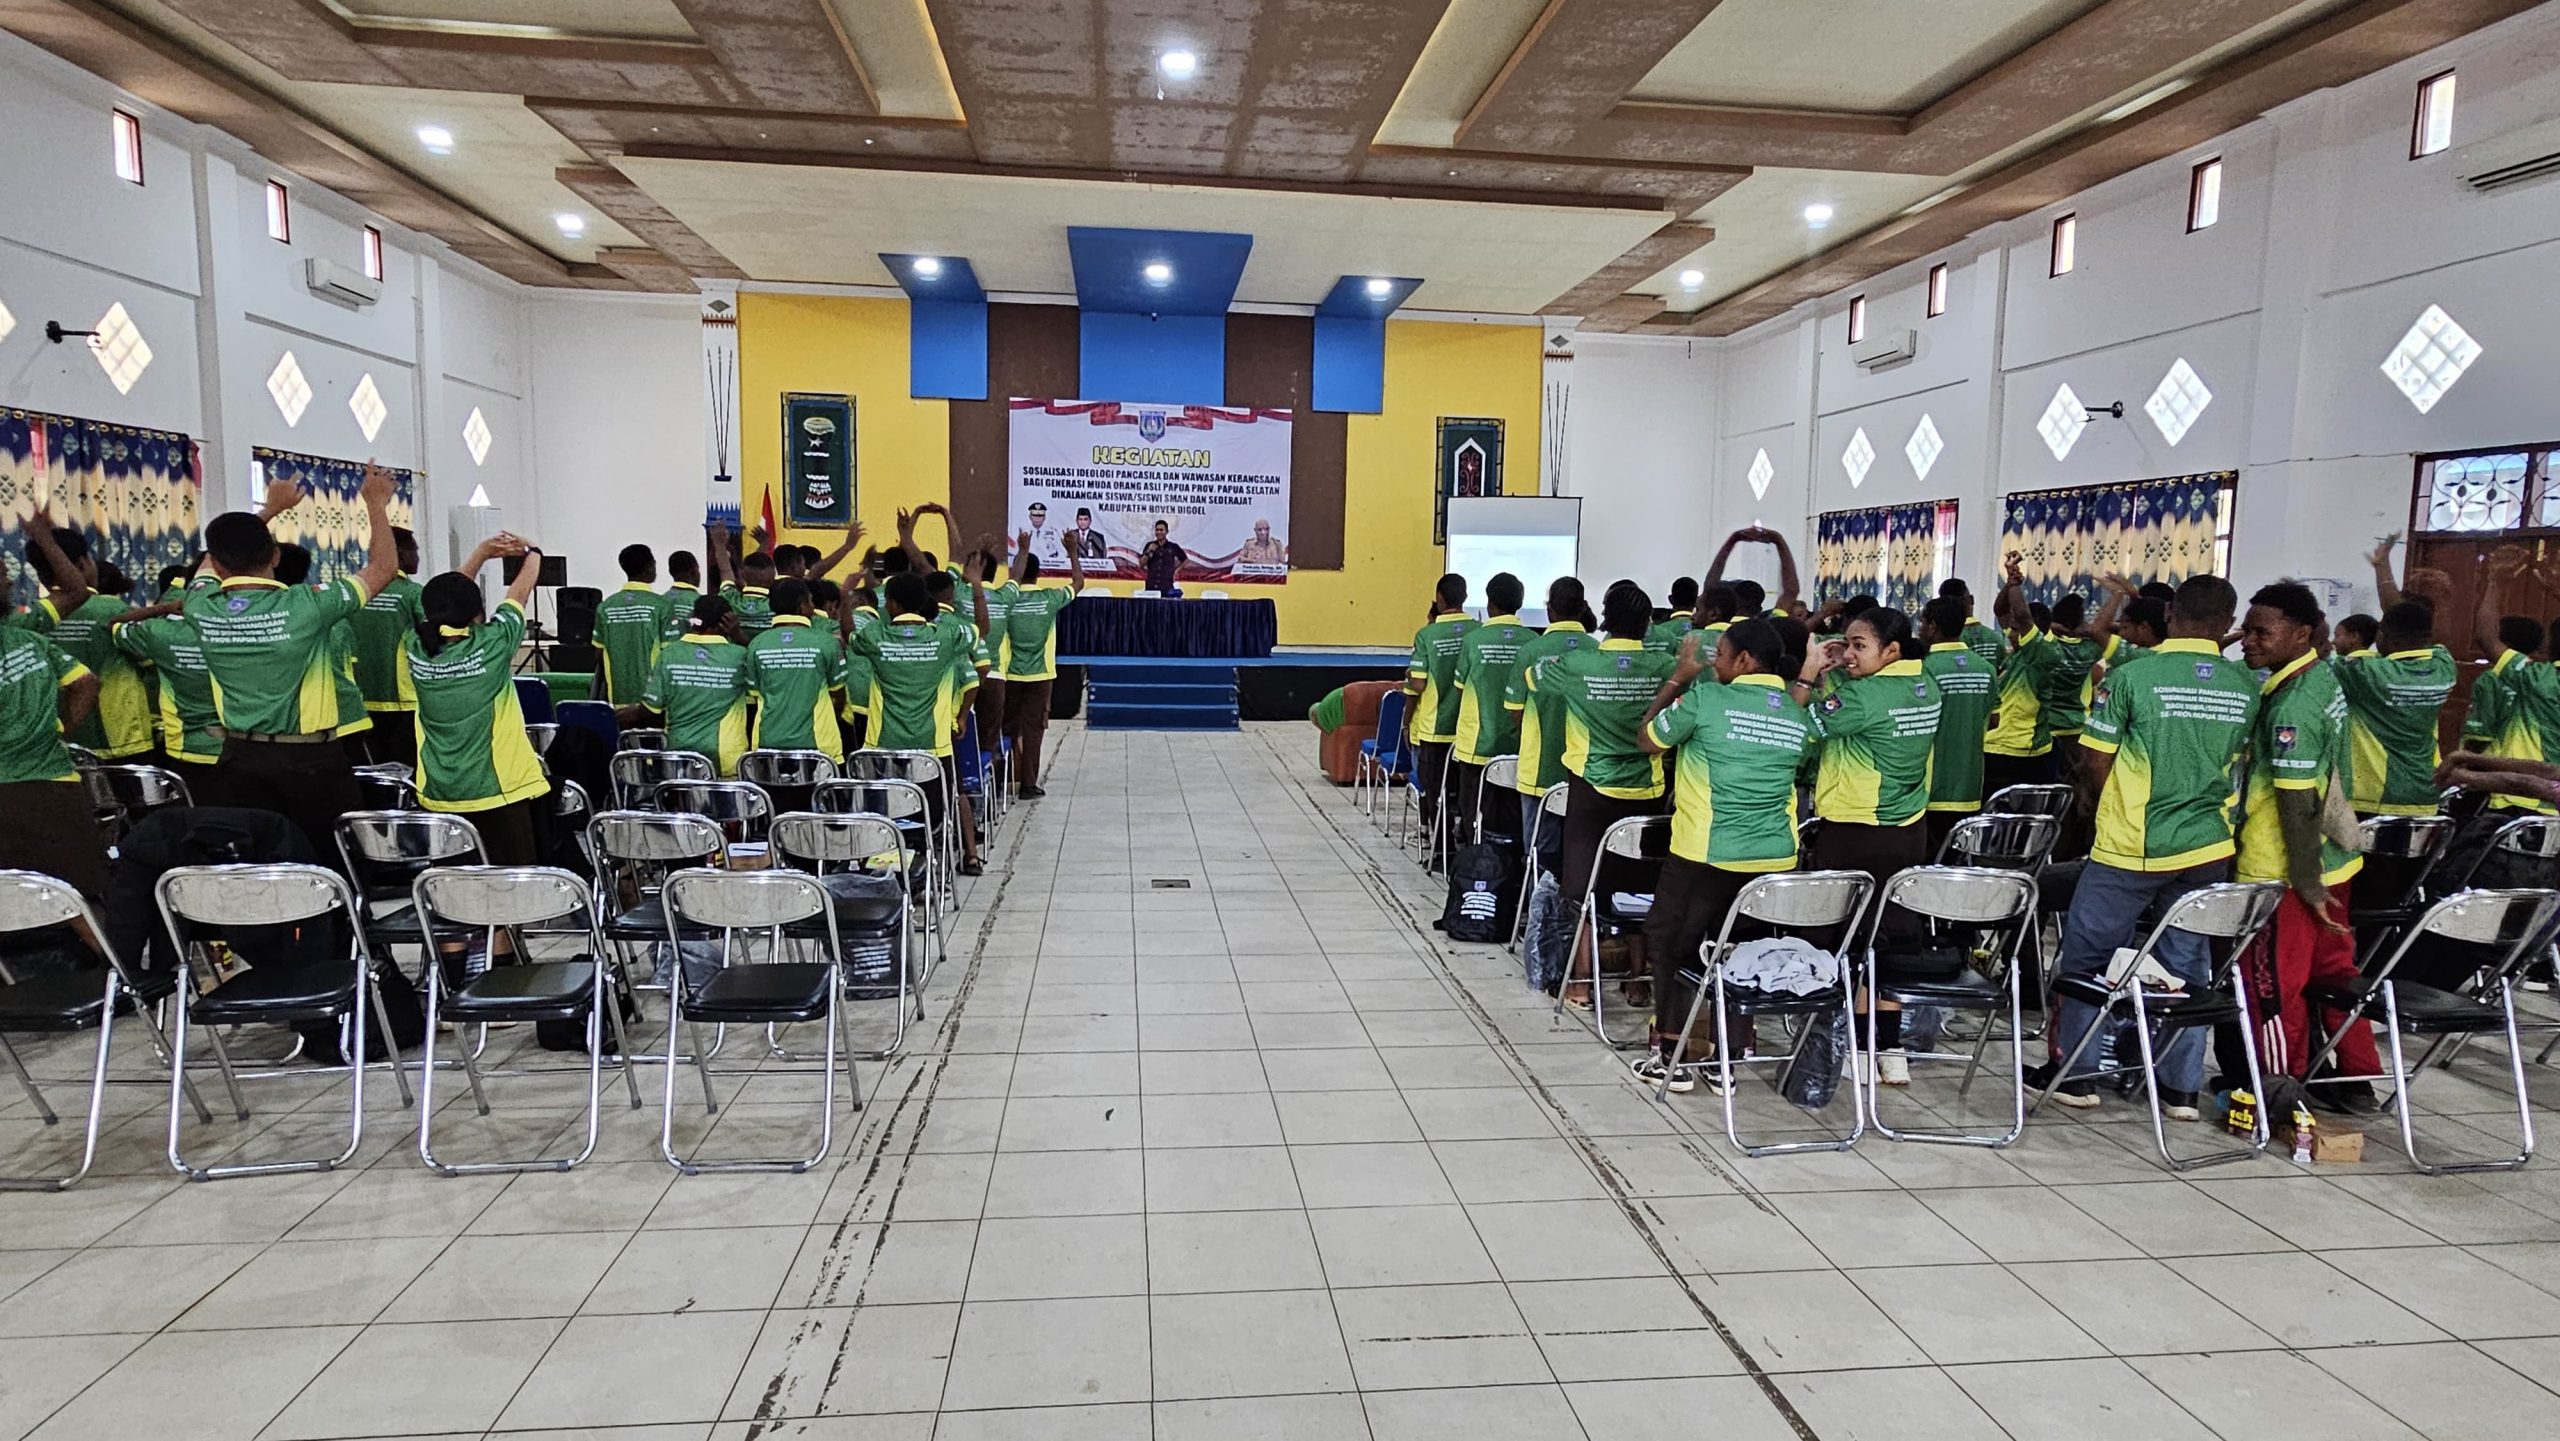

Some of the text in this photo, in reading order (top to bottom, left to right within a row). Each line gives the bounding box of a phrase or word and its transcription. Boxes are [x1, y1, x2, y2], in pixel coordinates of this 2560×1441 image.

[1093, 445, 1210, 468] KEGIATAN
[1023, 466, 1280, 484] SOSIALISASI IDEOLOGI PANCASILA DAN WAWASAN KEBANGSAAN
[1023, 478, 1280, 495] BAGI GENERASI MUDA ORANG ASLI PAPUA PROV. PAPUA SELATAN
[1051, 490, 1103, 500] DIKALANGAN
[1105, 491, 1162, 502] SISWA/SISWI
[1190, 495, 1207, 504] DAN
[1209, 496, 1252, 505] SEDERAJAT
[1099, 503, 1206, 516] KABUPATEN BOVEN DIGOEL
